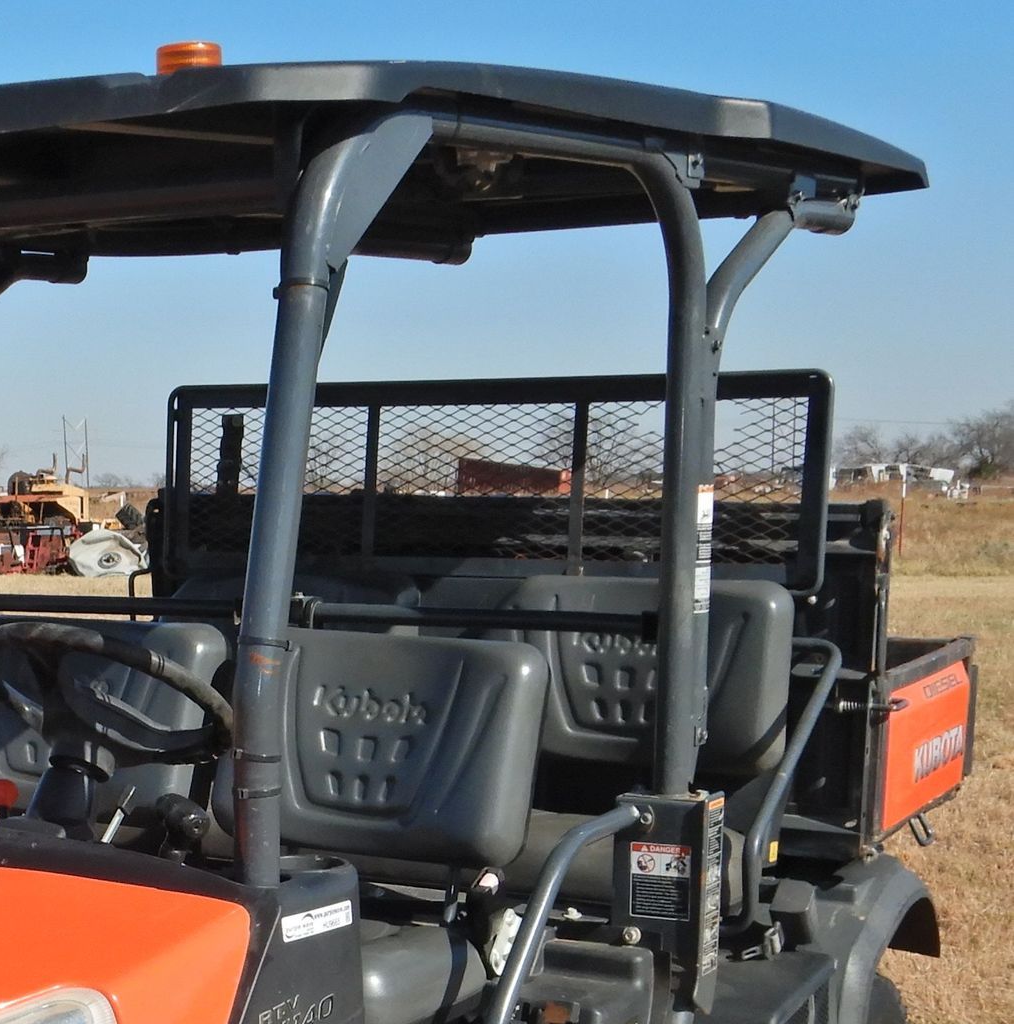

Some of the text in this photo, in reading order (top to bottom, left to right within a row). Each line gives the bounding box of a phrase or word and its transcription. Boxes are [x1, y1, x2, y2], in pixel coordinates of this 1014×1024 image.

[922, 673, 963, 698] DIESEL
[312, 684, 427, 726] Kubota
[914, 724, 964, 783] KUBOTA
[649, 845, 681, 854] DANGER
